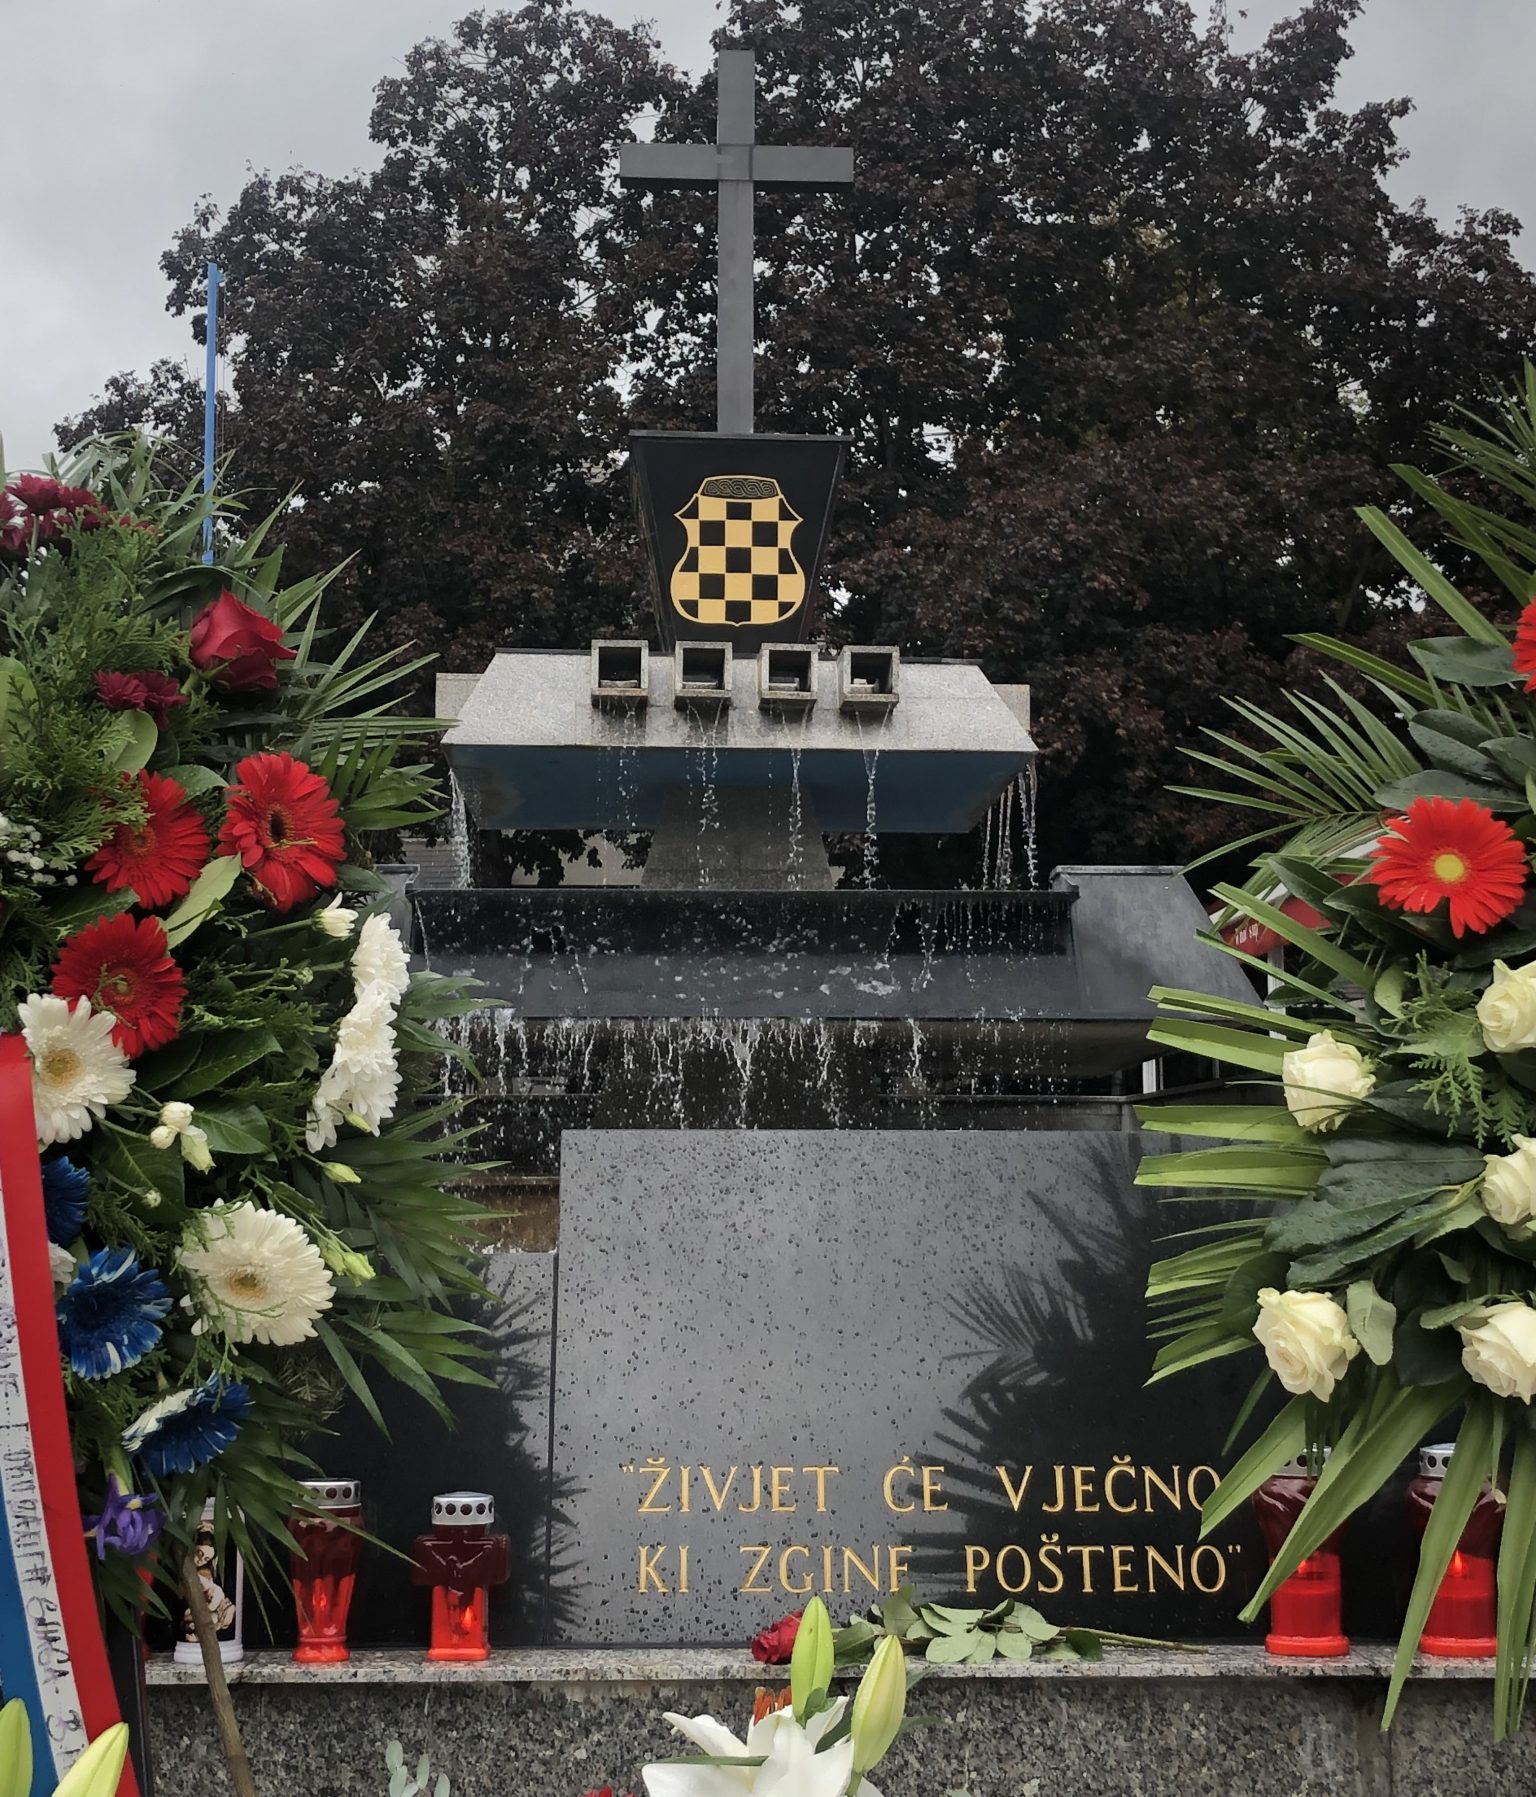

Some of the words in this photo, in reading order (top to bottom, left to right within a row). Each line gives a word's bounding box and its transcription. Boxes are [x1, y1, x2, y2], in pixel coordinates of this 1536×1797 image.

[622, 1456, 840, 1512] "ŽIVJET
[882, 1455, 949, 1512] ĆE
[995, 1454, 1221, 1513] VJEČNO
[638, 1545, 689, 1593] KI
[964, 1532, 1242, 1593] POŠTENO"
